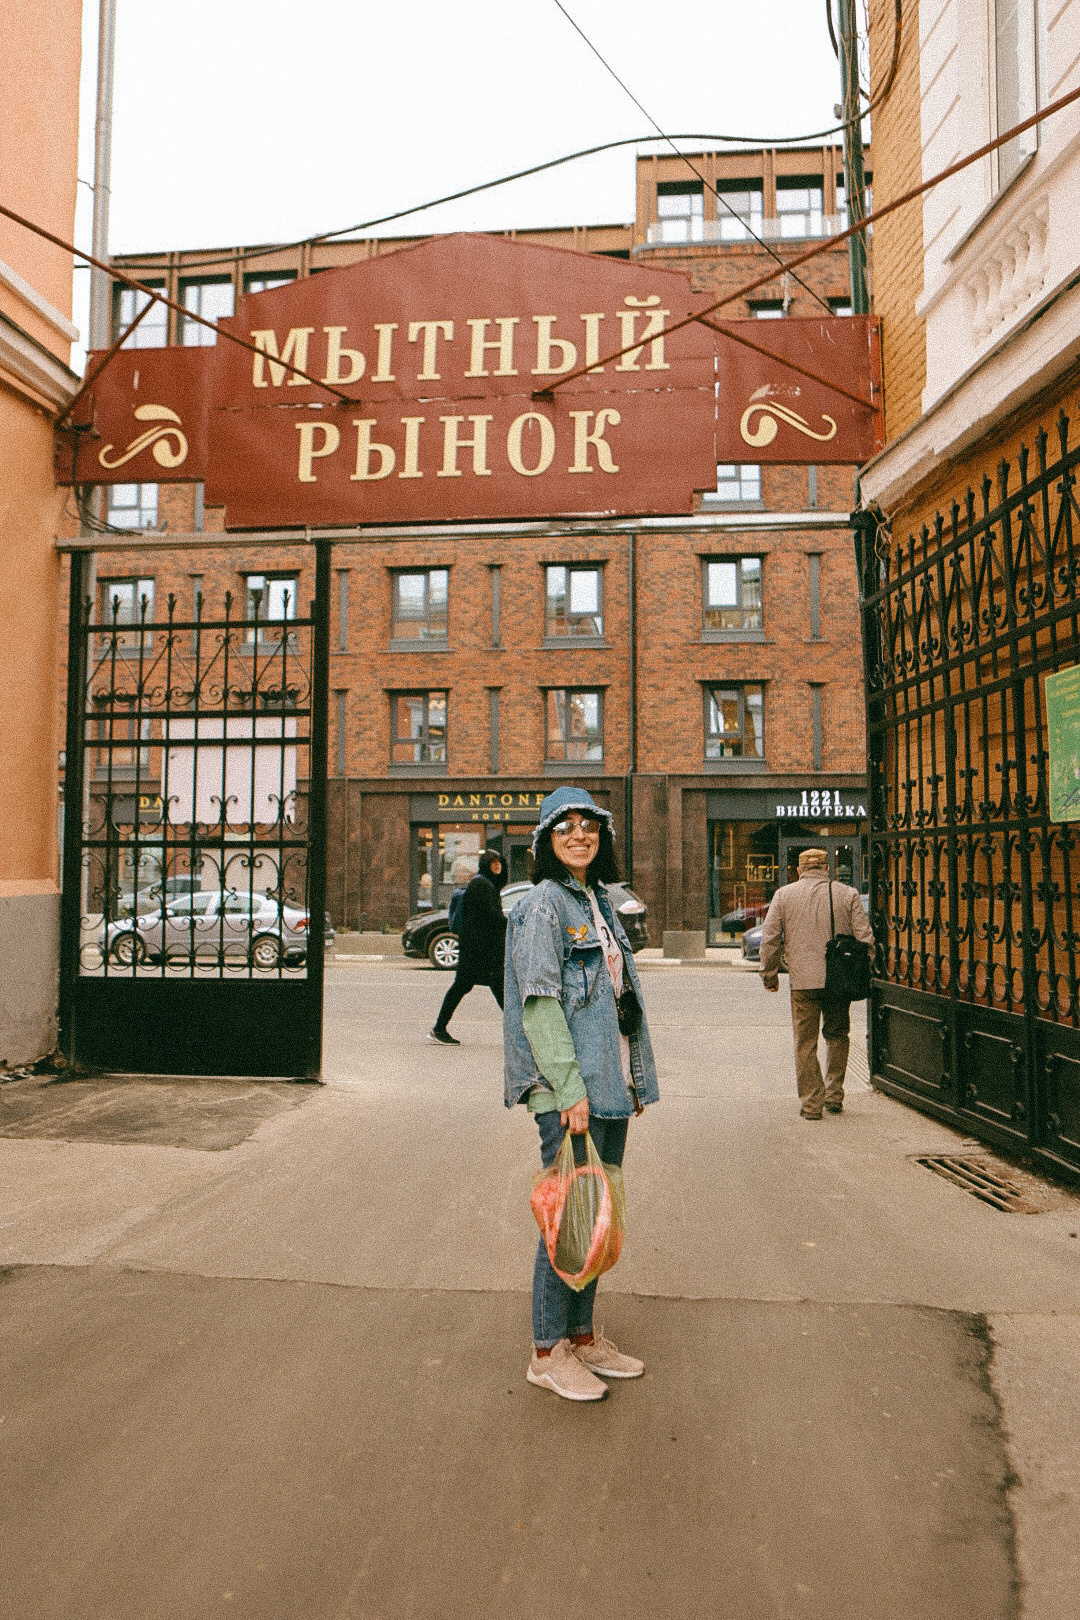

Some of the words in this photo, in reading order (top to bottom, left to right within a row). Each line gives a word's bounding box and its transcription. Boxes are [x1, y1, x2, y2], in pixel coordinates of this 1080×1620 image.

[250, 295, 672, 389] МЫТНЫЙ
[295, 407, 621, 484] РЫНОК
[775, 805, 867, 817] ВИНОТЕКА
[801, 790, 841, 805] 1221
